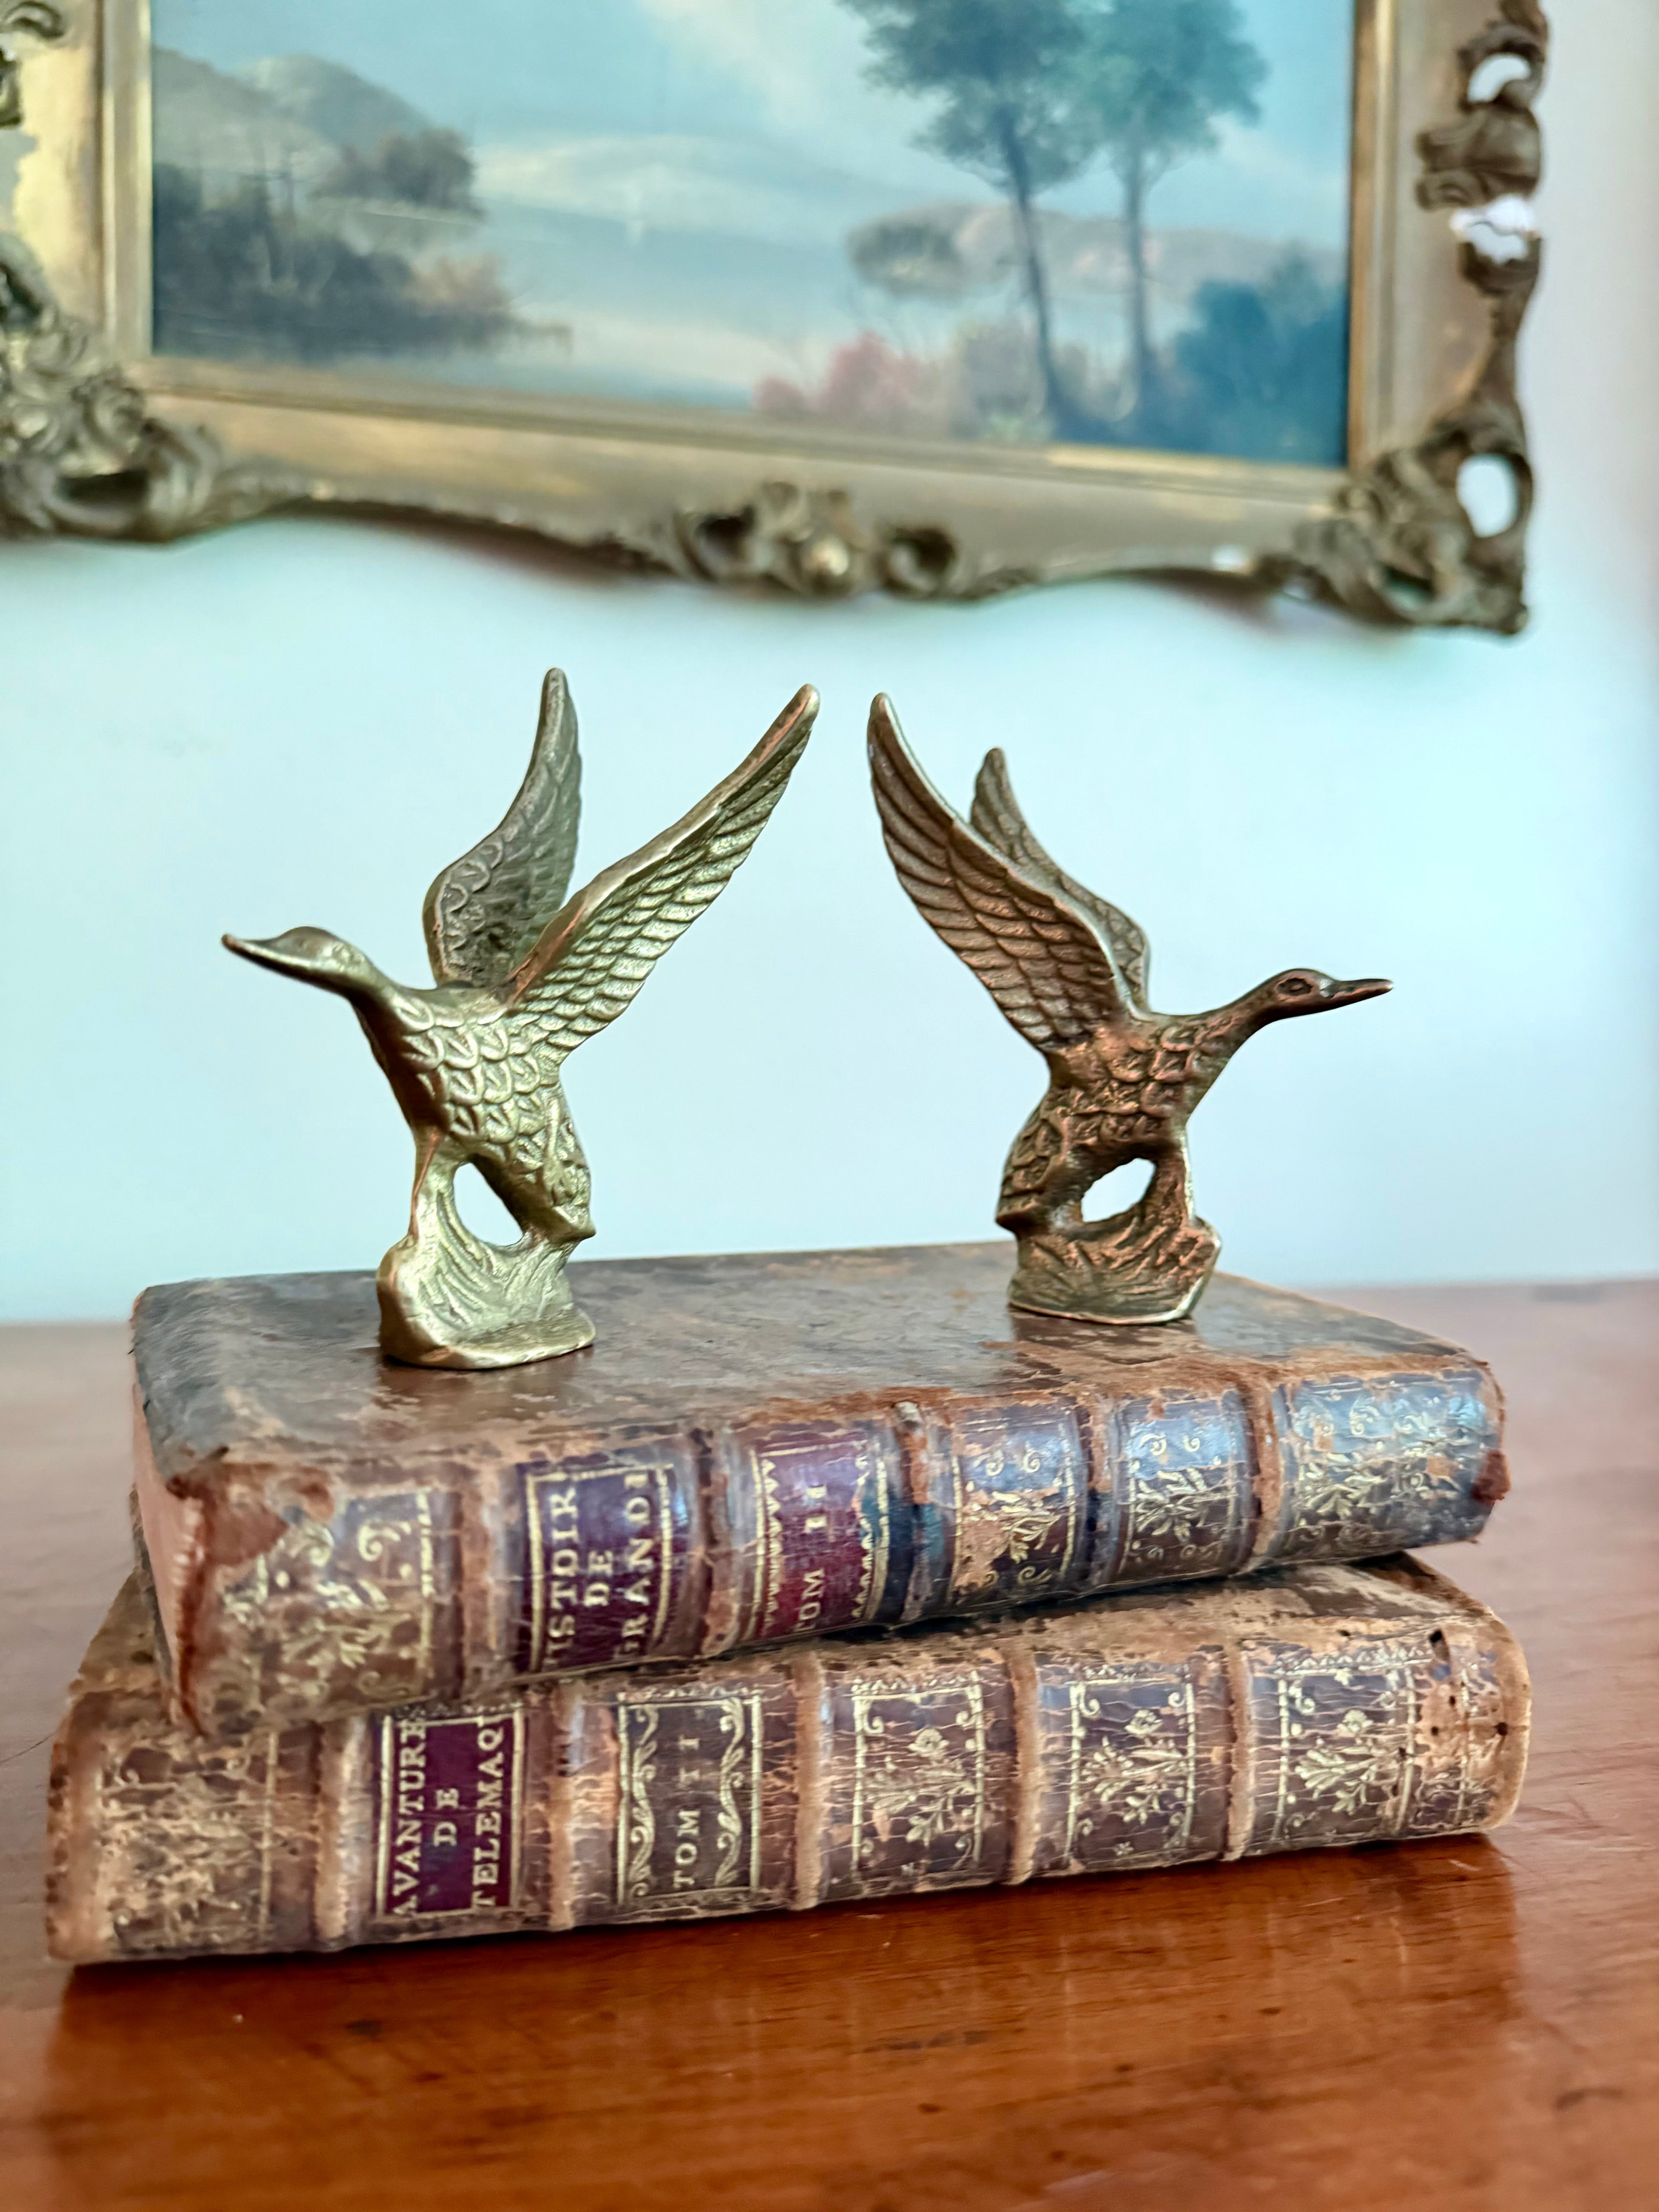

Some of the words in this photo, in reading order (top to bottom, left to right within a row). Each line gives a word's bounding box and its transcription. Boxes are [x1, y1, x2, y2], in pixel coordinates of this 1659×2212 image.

[583, 1548, 613, 1607] DE
[794, 1568, 825, 1631] TOM
[392, 1717, 427, 1915] AVANTURE
[433, 1787, 460, 1847] DE
[673, 1809, 701, 1889] TOM
